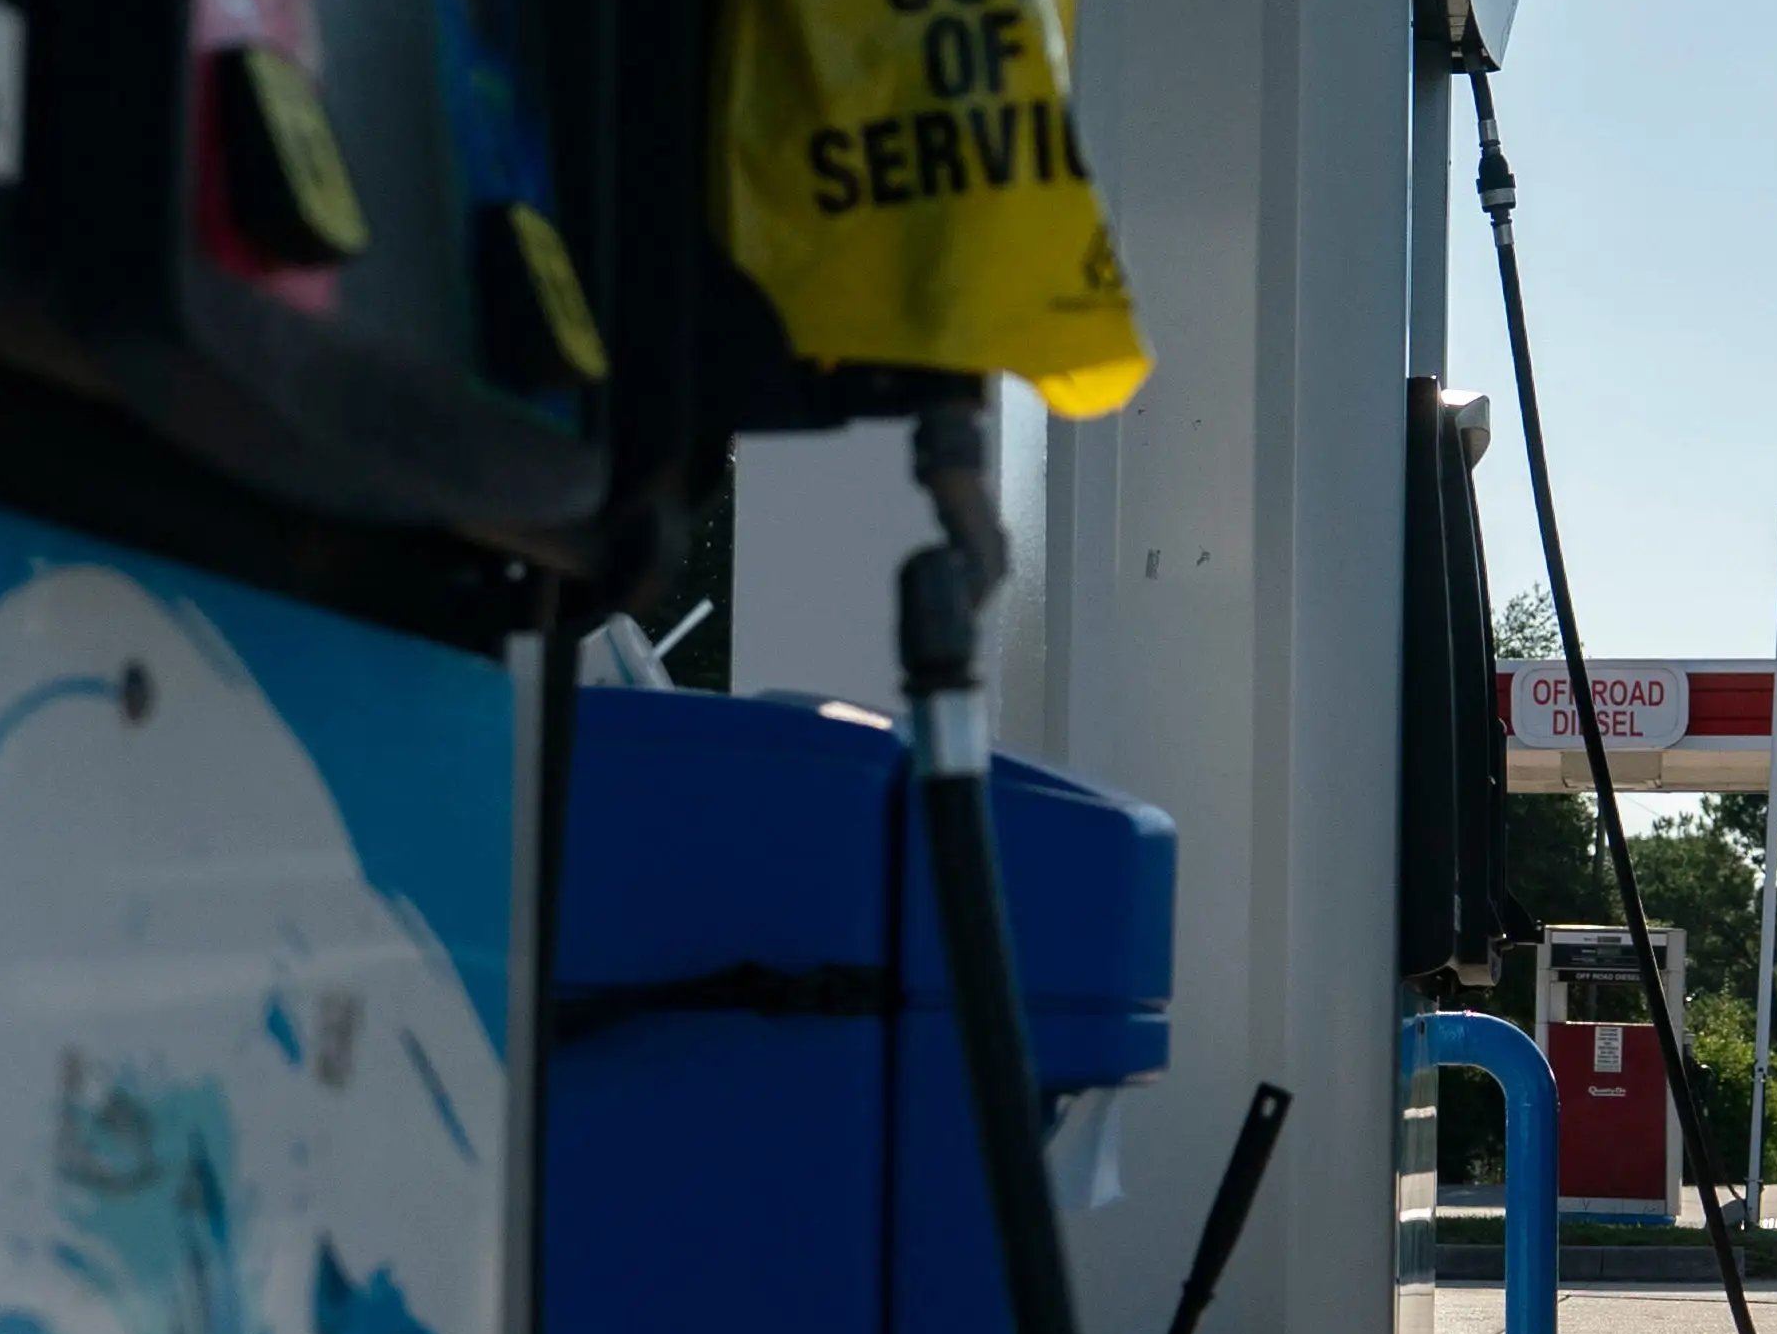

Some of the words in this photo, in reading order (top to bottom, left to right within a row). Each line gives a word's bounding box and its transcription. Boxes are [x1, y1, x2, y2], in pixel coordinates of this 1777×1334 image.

[923, 9, 1026, 100] OF
[1591, 680, 1664, 706] ROAD
[1553, 710, 1644, 737] DISEL
[1592, 973, 1614, 982] ROAD
[1615, 973, 1641, 982] DIESEL
